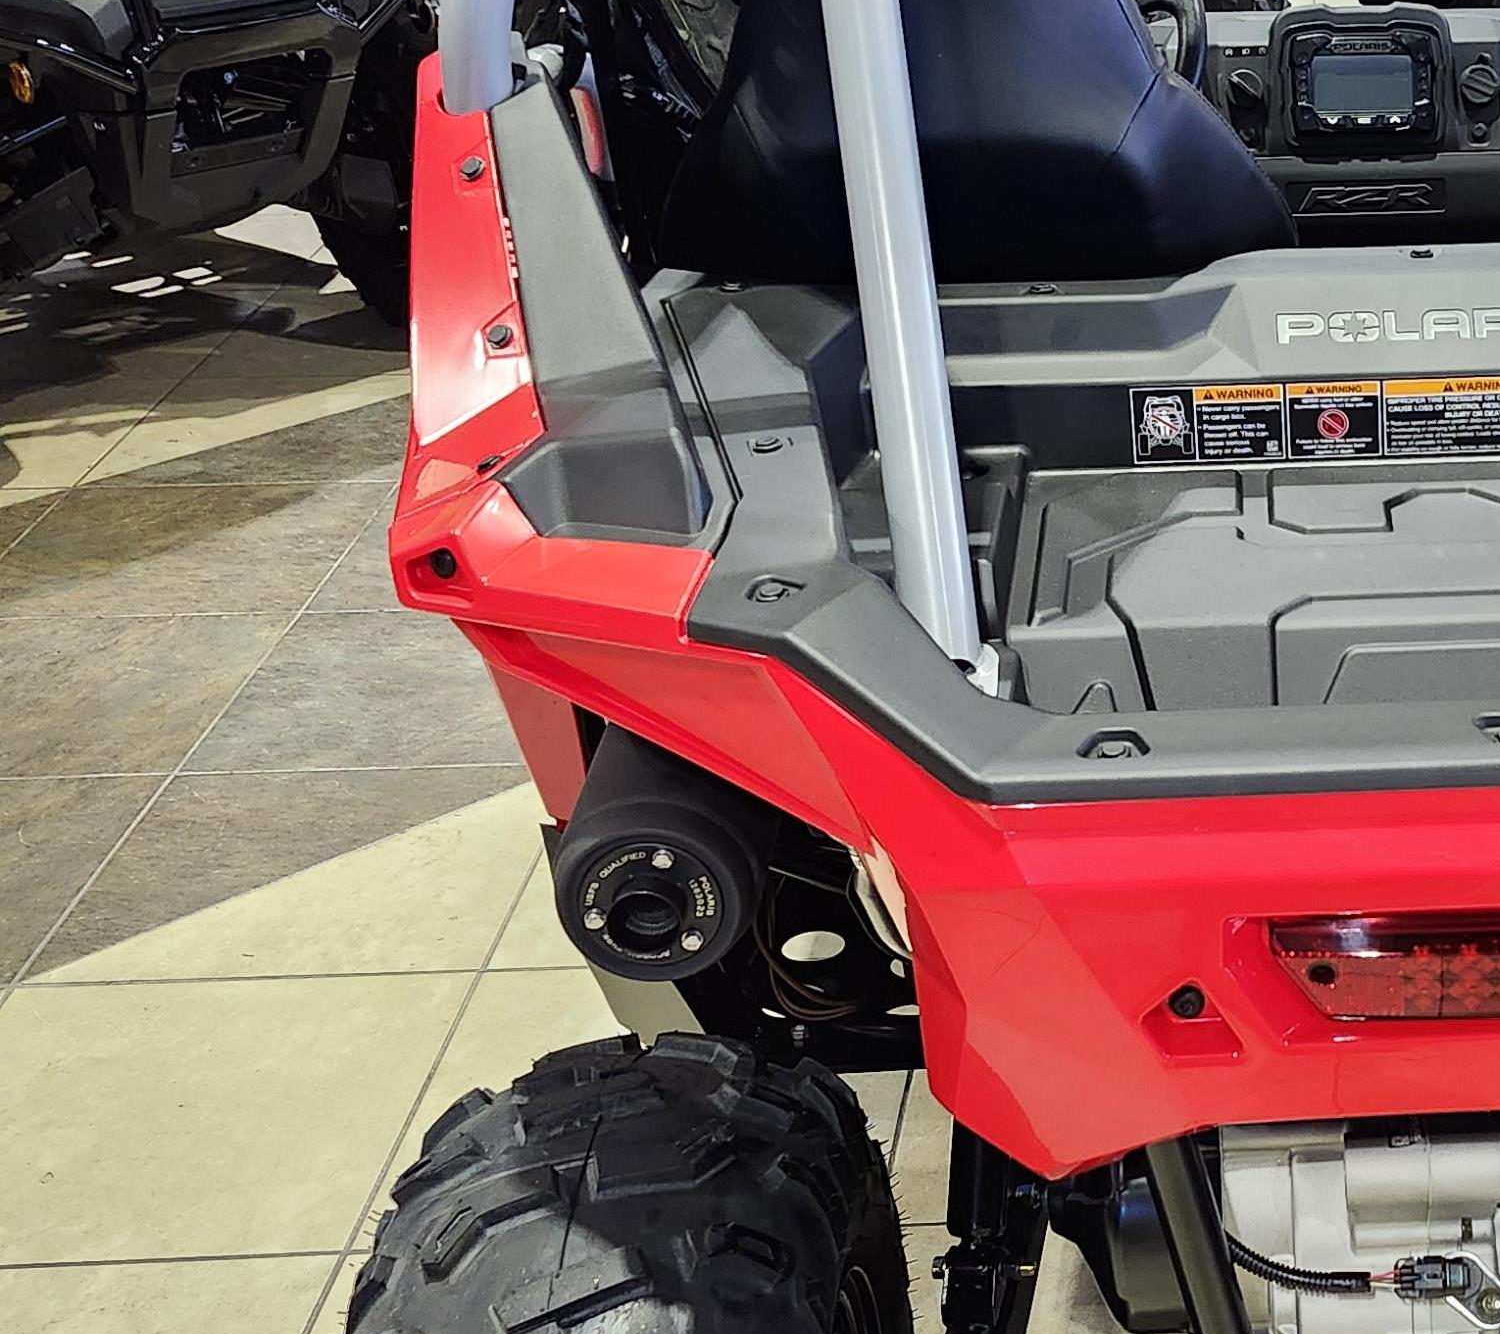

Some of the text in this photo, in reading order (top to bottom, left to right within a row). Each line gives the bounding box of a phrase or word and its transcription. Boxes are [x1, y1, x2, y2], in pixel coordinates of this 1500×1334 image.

[1333, 41, 1390, 52] POLARIS
[1216, 388, 1274, 400] WARNING
[1315, 384, 1362, 394] WARNING
[598, 850, 647, 879] QUALIFIED
